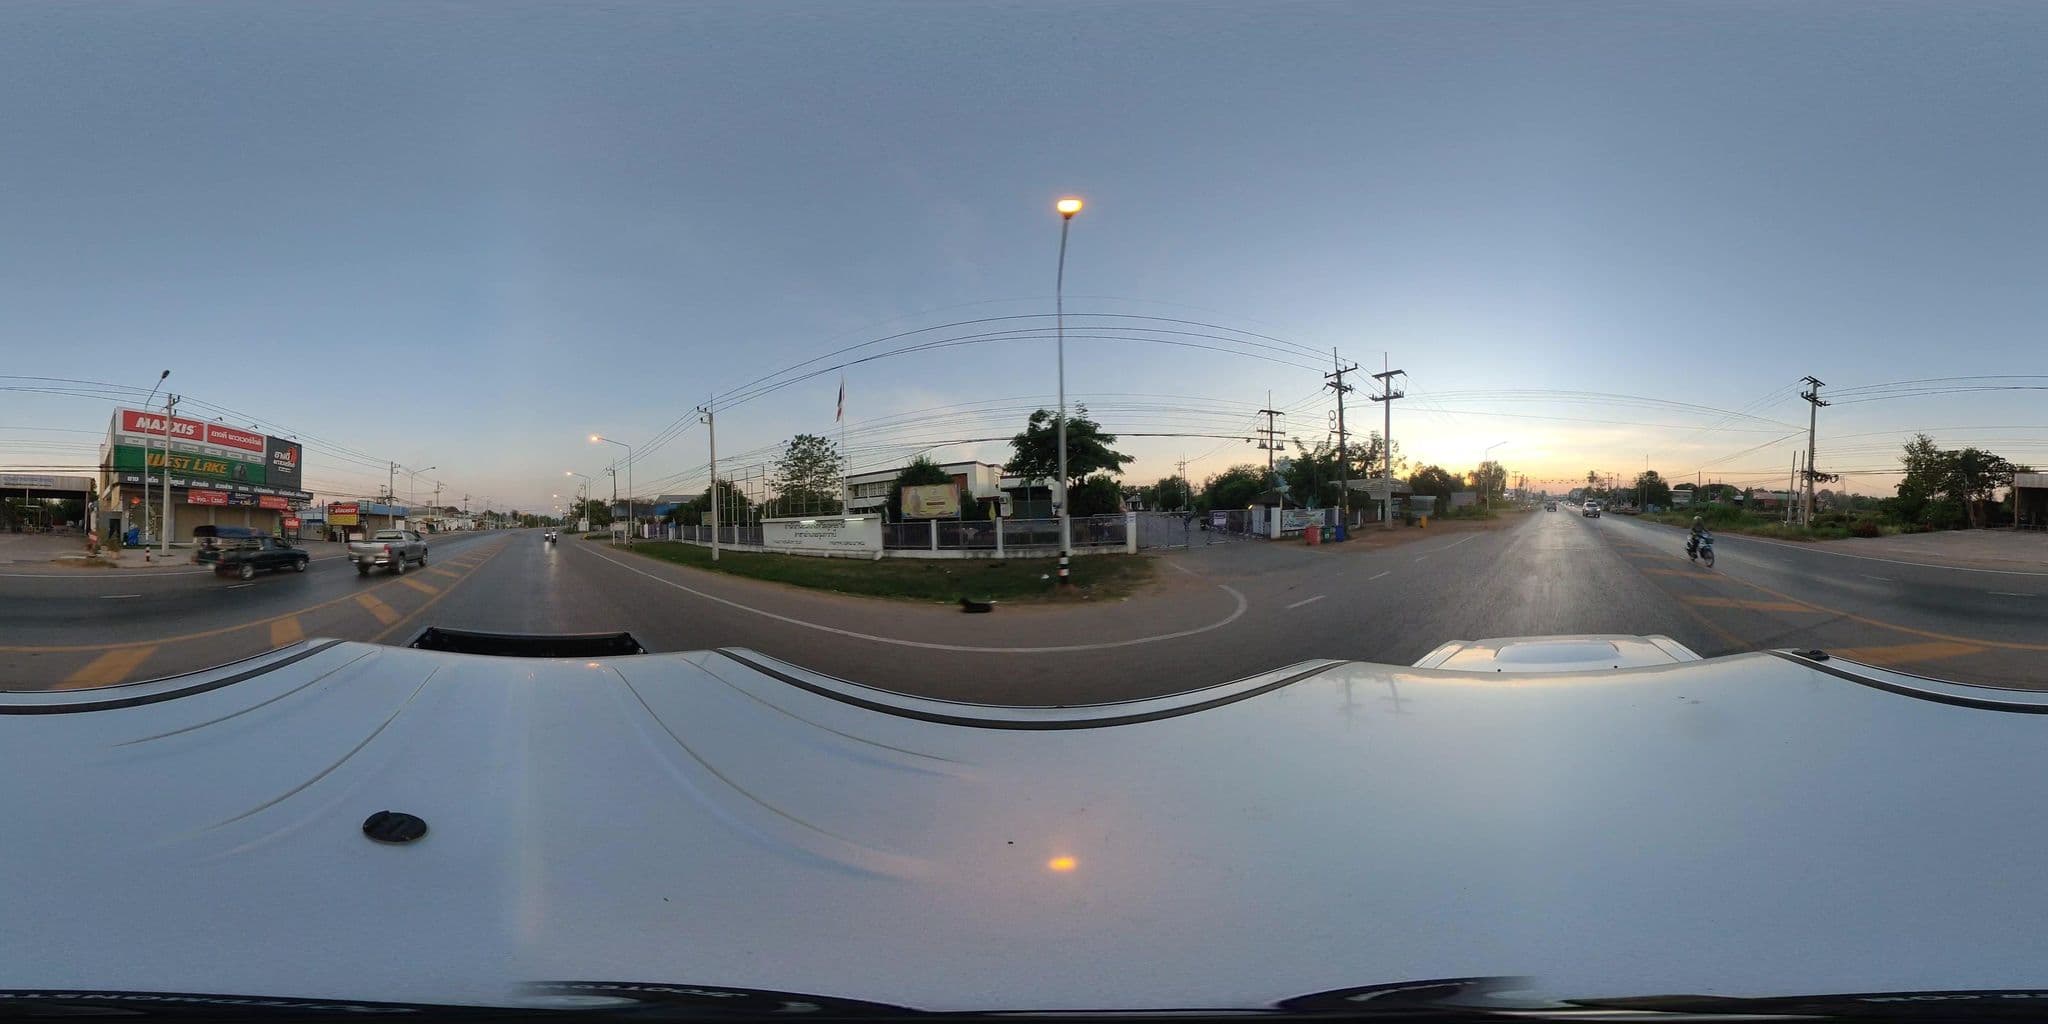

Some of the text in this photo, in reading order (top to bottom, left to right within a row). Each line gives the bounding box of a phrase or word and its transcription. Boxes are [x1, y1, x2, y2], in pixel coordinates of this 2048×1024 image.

[136, 417, 195, 435] MAXXIS
[148, 453, 228, 473] WEST LAKE
